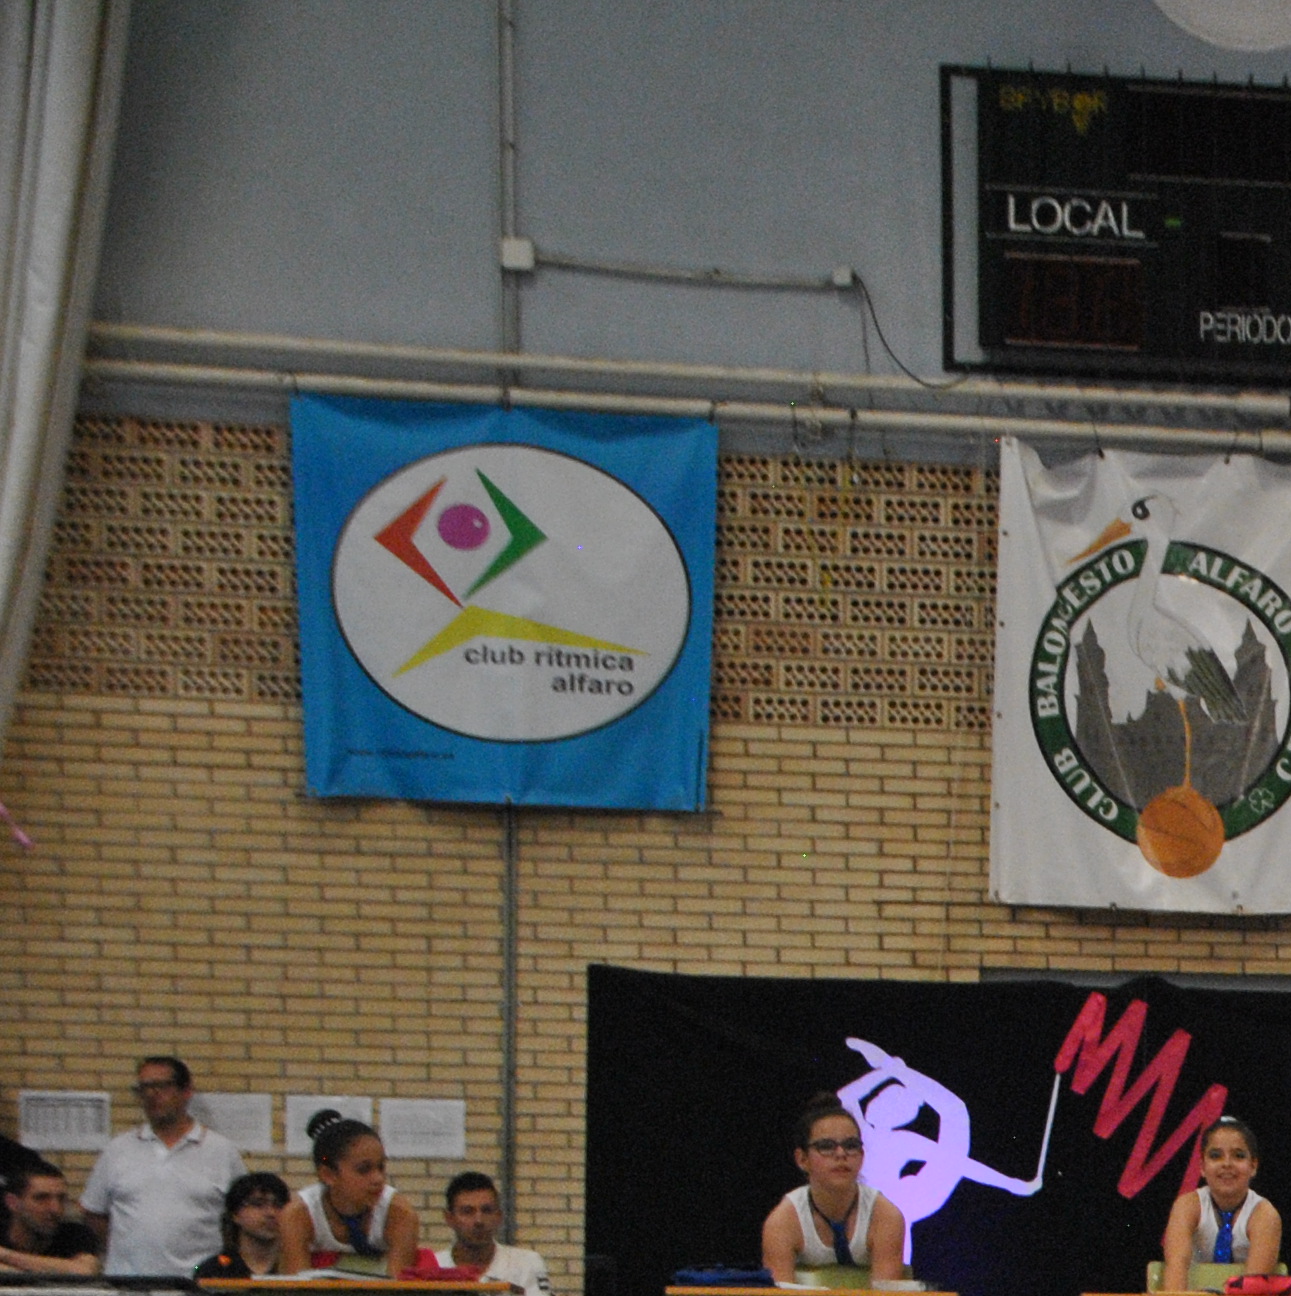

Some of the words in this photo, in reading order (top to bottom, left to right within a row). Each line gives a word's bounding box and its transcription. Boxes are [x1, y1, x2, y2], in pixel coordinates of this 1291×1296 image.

[1007, 194, 1144, 239] LOCAL
[464, 645, 525, 667] club
[551, 672, 634, 697] alfaro
[1053, 746, 1119, 823] CLUB
